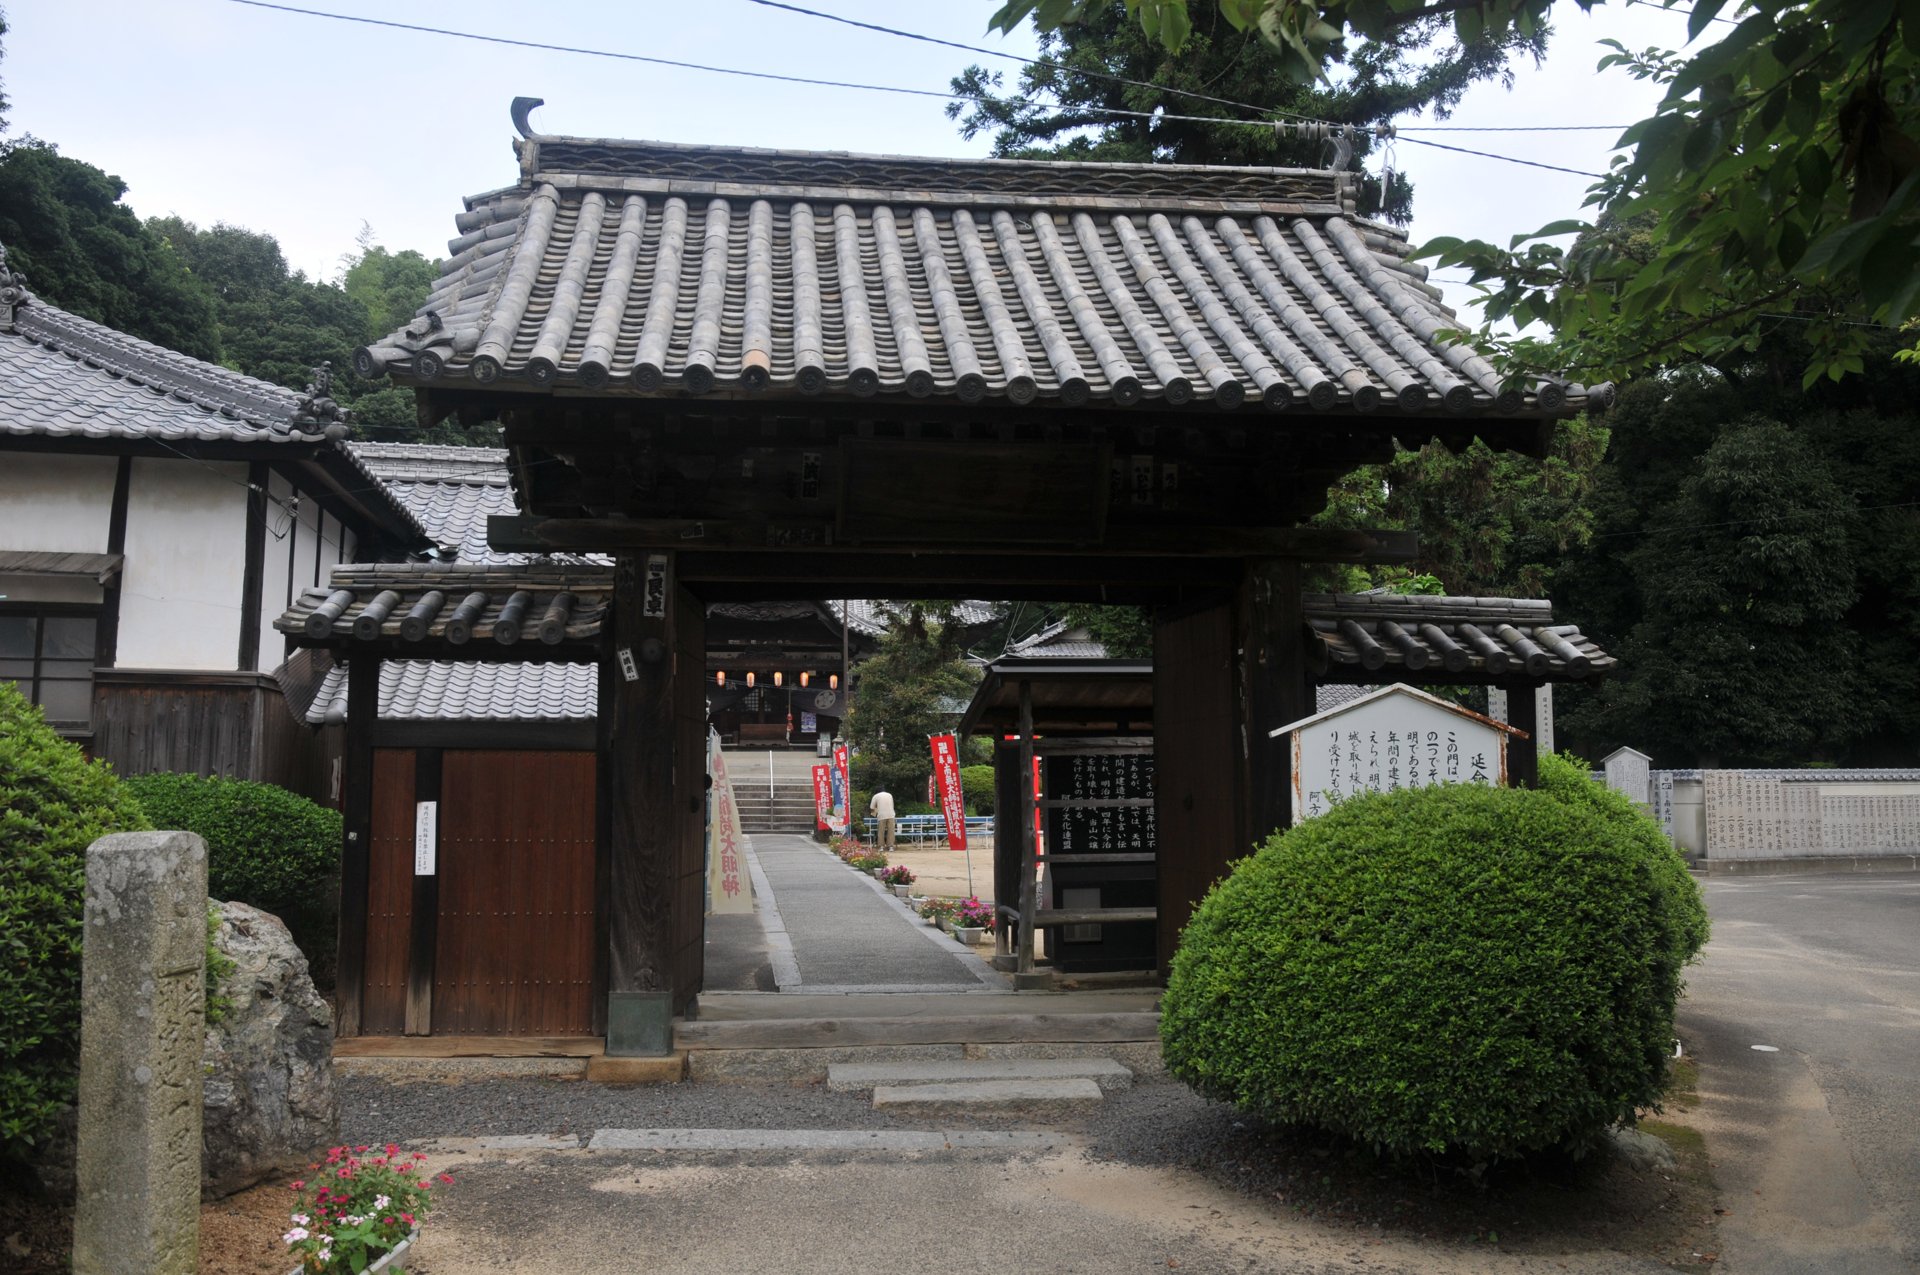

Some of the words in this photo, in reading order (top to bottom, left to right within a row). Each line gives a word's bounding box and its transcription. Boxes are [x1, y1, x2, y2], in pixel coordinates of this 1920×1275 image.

[1446, 731, 1460, 783] この門は、
[1309, 791, 1321, 816] 阿方
